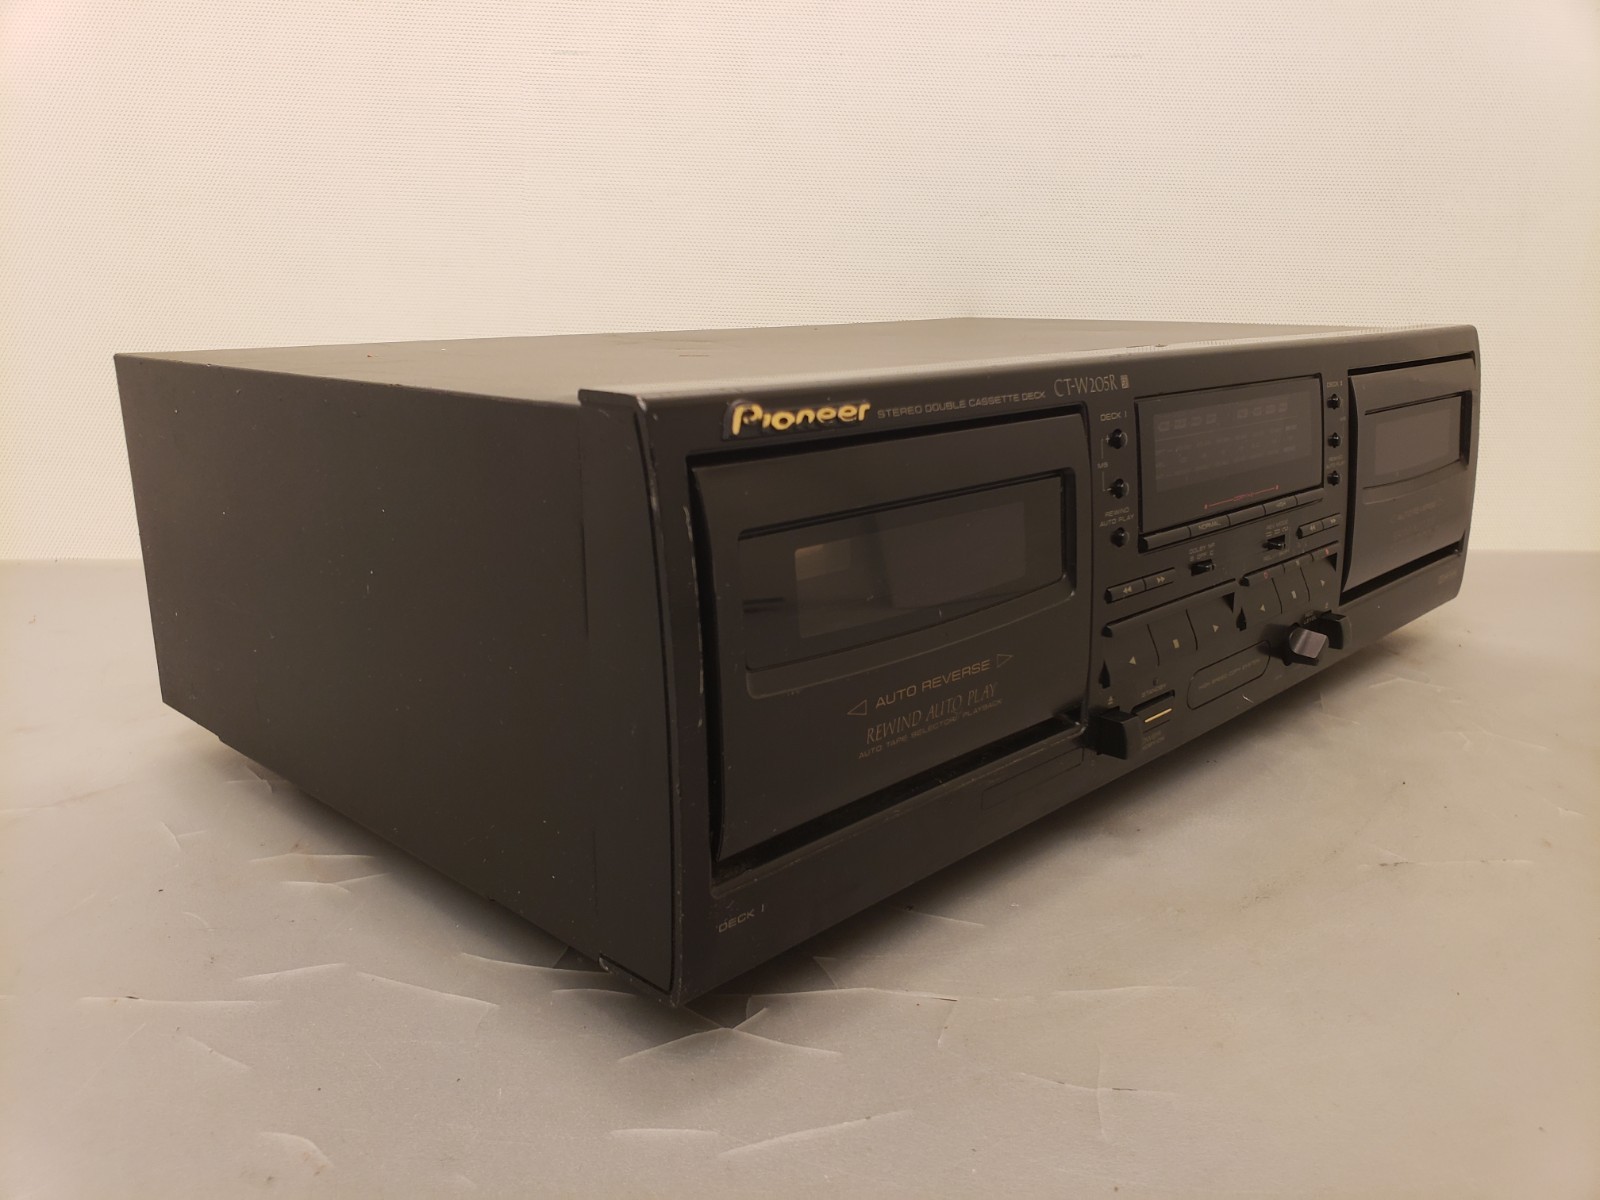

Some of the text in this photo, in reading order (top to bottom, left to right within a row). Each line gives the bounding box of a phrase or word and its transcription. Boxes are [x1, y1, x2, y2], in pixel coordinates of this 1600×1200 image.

[1054, 374, 1118, 397] CT-W205R
[877, 390, 1046, 419] STEREO DOUBLE CASSETTE DECK
[1100, 411, 1122, 421] DECK
[732, 402, 871, 436] Pioneer
[875, 659, 991, 710] AUTO REVERSE
[866, 682, 998, 744] REWIND AUTO PLAY
[858, 744, 883, 759] AUTO
[718, 908, 756, 933] DECK
